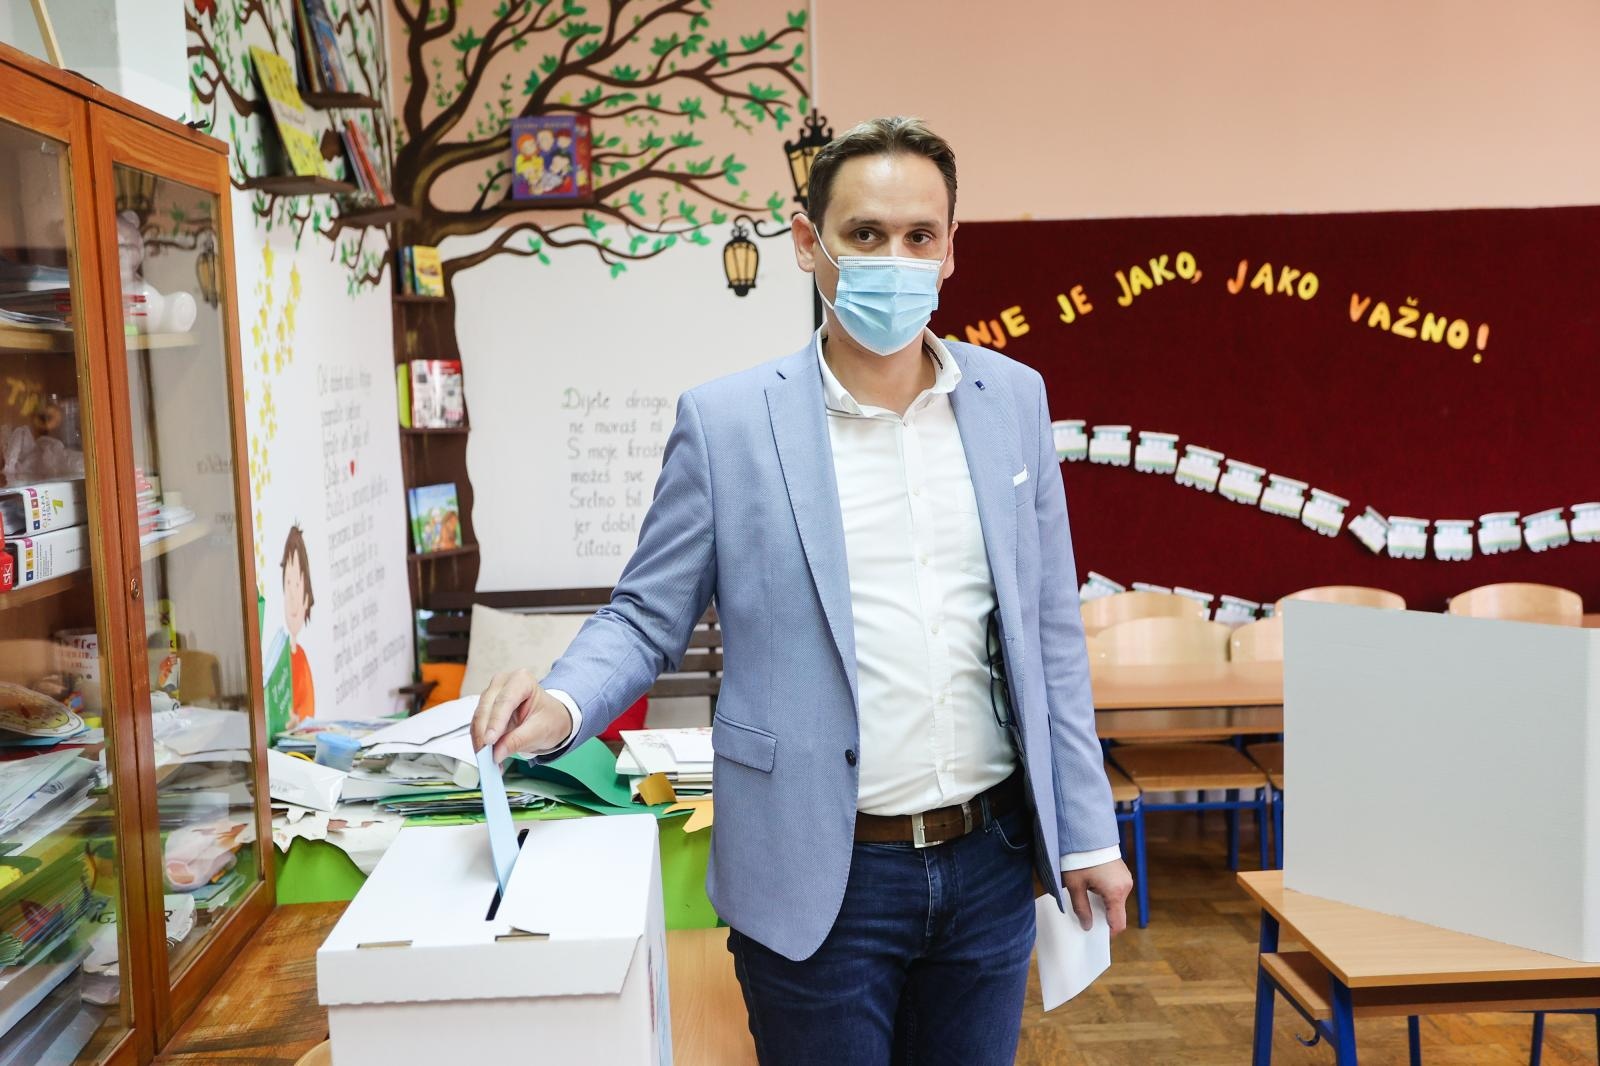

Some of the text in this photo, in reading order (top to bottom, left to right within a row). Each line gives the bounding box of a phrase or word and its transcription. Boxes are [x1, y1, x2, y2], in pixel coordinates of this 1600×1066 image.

[944, 251, 1490, 364] NJE JE JAKO, JAKO VAŽNO!
[561, 386, 610, 417] Dijete
[568, 421, 584, 434] ne
[594, 418, 636, 434] moraš
[567, 436, 581, 460] S
[570, 469, 644, 484] možeš sve
